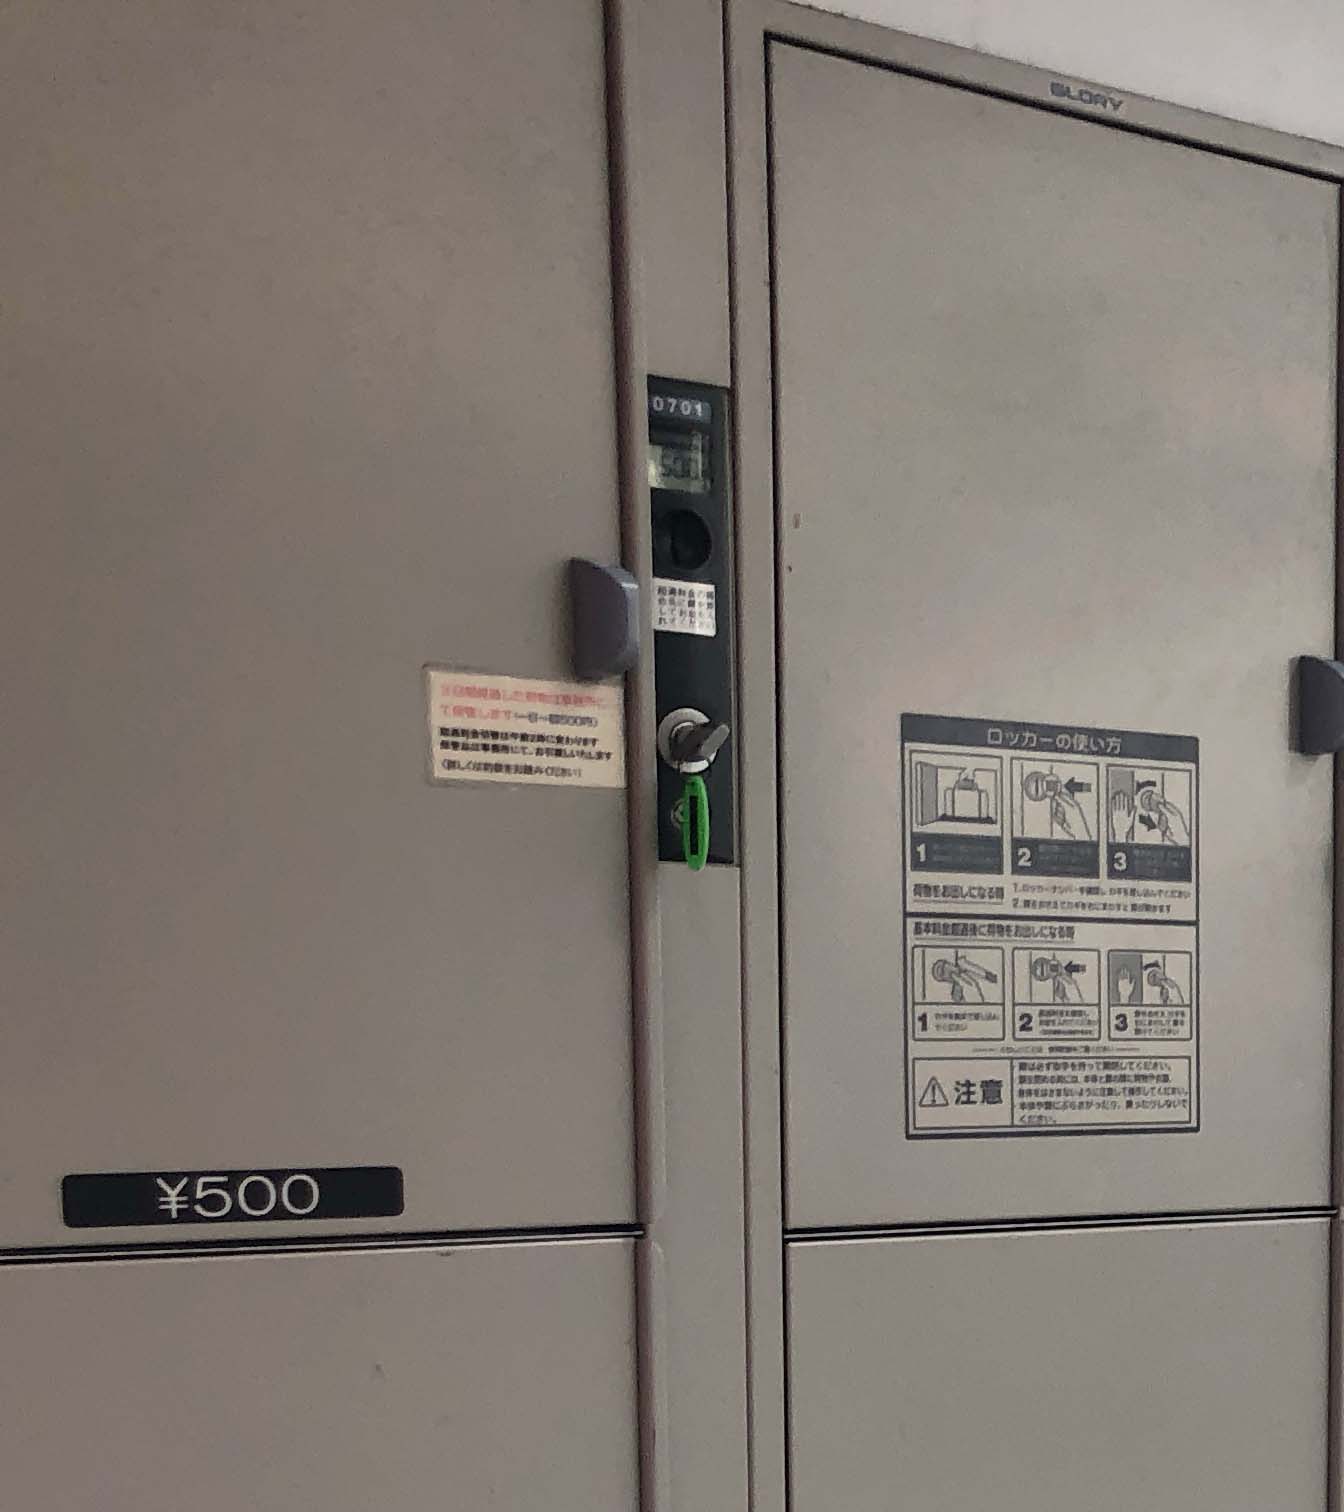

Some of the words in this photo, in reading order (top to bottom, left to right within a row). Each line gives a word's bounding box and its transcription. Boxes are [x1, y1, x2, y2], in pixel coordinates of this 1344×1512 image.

[1050, 82, 1123, 111] GLORY
[653, 396, 703, 417] 0701
[986, 726, 1123, 756] ロッカーの使い方
[917, 843, 926, 862] 1
[1017, 847, 1032, 867] 2
[1114, 851, 1127, 871] 3
[917, 1013, 928, 1032] 1
[1018, 1013, 1033, 1032] 2
[1115, 1013, 1128, 1032] 3
[955, 1079, 1003, 1105] 注意
[158, 1175, 321, 1219] ¥500
